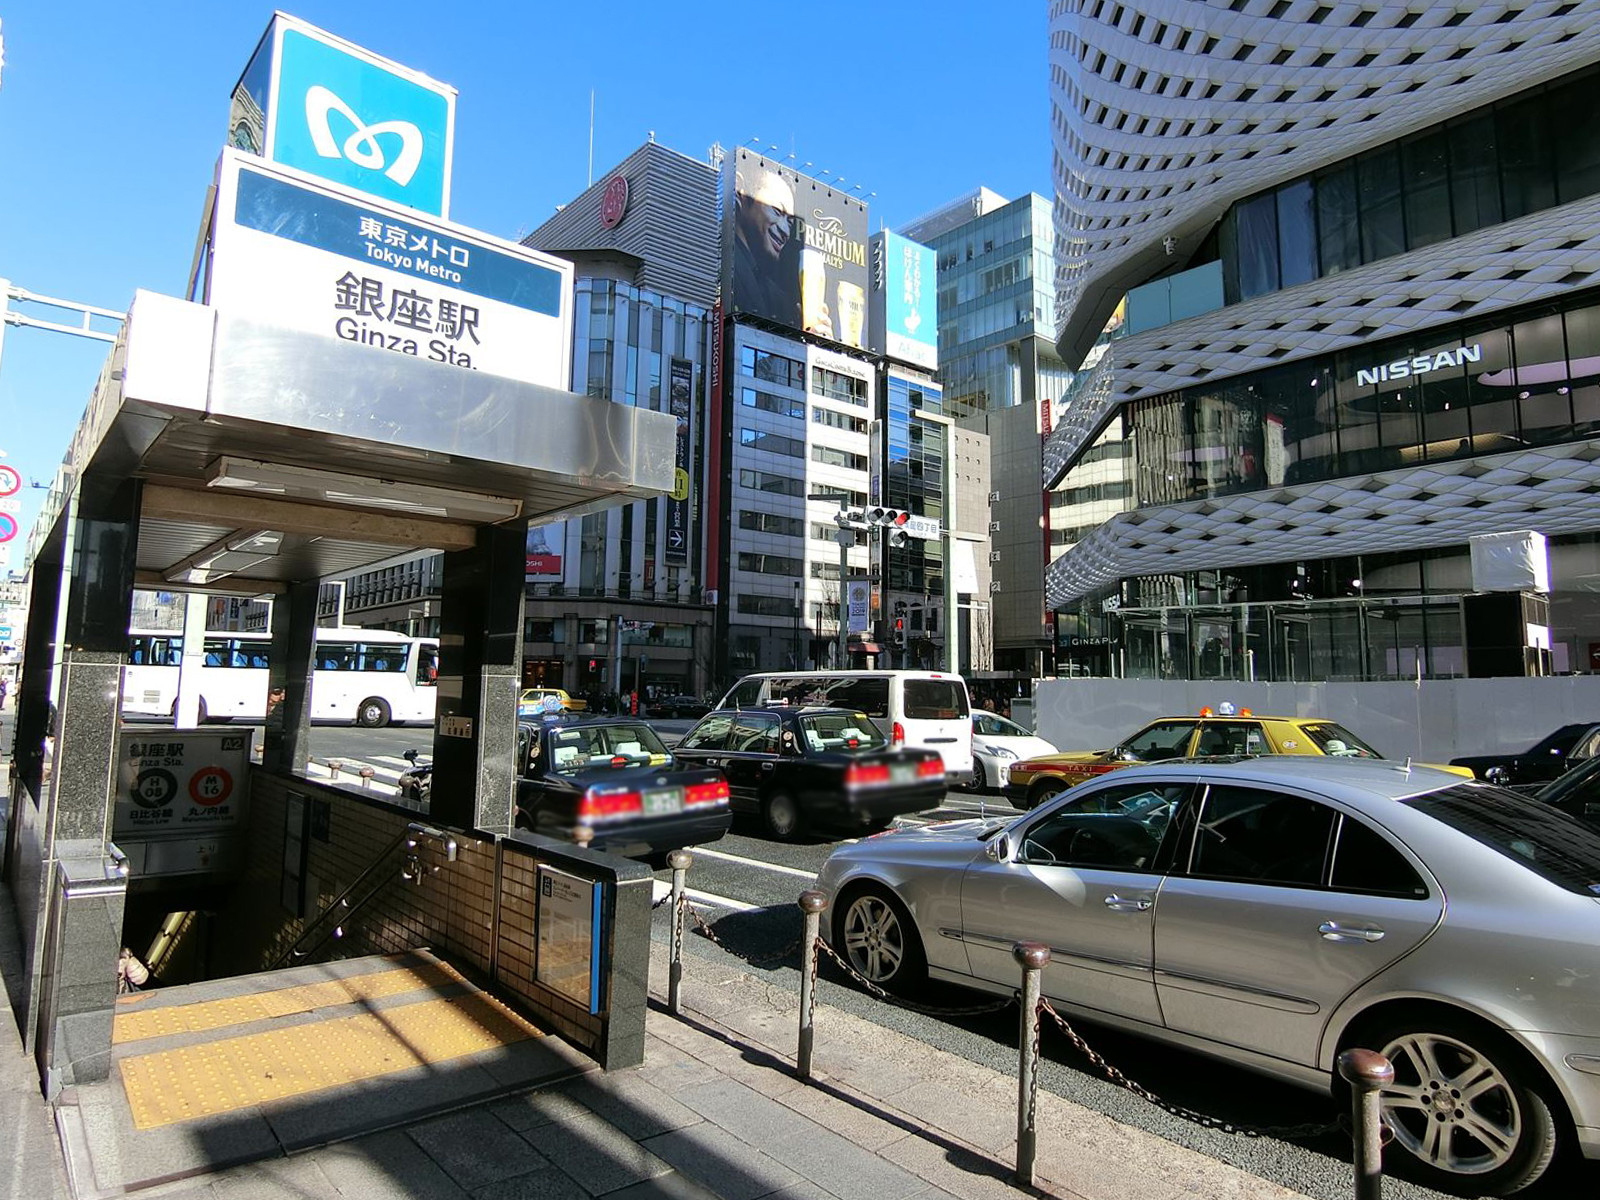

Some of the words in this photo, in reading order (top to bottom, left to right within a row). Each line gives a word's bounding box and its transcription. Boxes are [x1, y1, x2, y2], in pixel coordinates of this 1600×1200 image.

[814, 208, 848, 237] The
[359, 216, 470, 268] 東京メトロ
[795, 218, 866, 267] PREMIUM
[364, 242, 412, 271] Tokyo
[415, 257, 462, 284] Metro
[334, 270, 481, 346] 銀座駅
[335, 316, 418, 356] Ginza
[428, 339, 478, 370] Sta.
[712, 311, 721, 387] MITSUKOSHI
[1356, 344, 1480, 387] NISSAN
[1071, 638, 1101, 646] GINZA
[130, 743, 184, 757] 銀座駅
[223, 738, 243, 749] A2
[163, 757, 184, 766] Sta.
[150, 777, 160, 787] H
[203, 785, 219, 795] 16
[205, 776, 217, 785] M
[145, 787, 162, 798] 08
